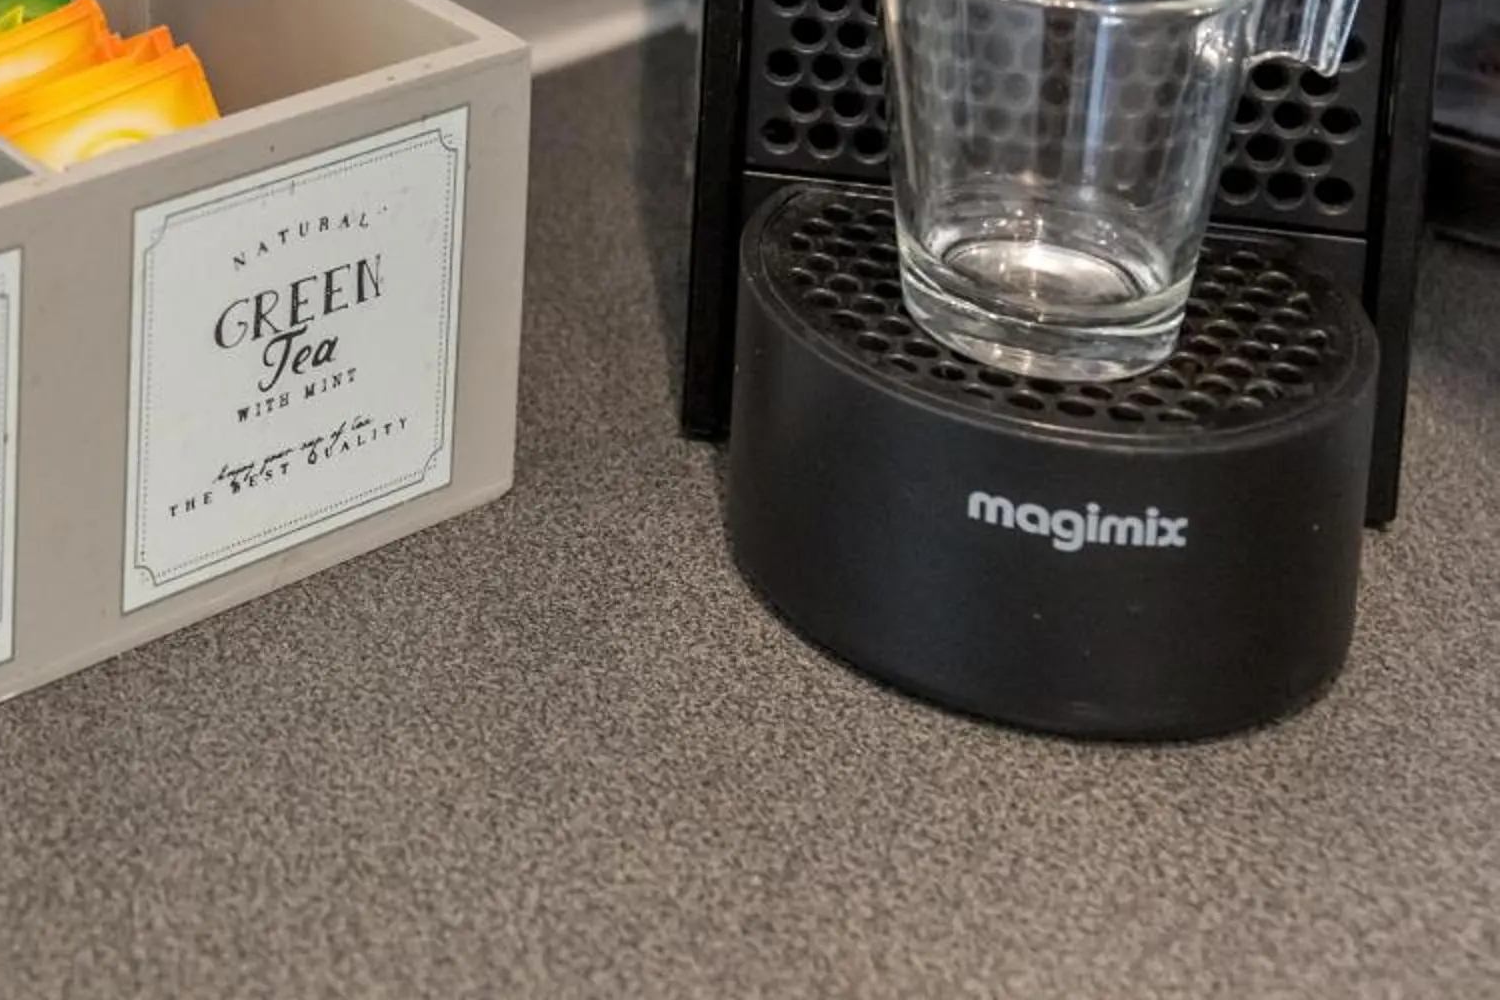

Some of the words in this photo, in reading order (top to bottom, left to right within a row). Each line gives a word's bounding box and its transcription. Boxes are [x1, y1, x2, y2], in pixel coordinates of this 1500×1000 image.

[232, 212, 370, 271] NATURAL
[214, 253, 382, 349] GREEN
[257, 324, 339, 393] Tea
[237, 391, 291, 423] WITH
[304, 368, 358, 399] MINT
[168, 491, 213, 517] THE
[307, 417, 408, 465] QUALITY
[967, 491, 1188, 552] magimix
